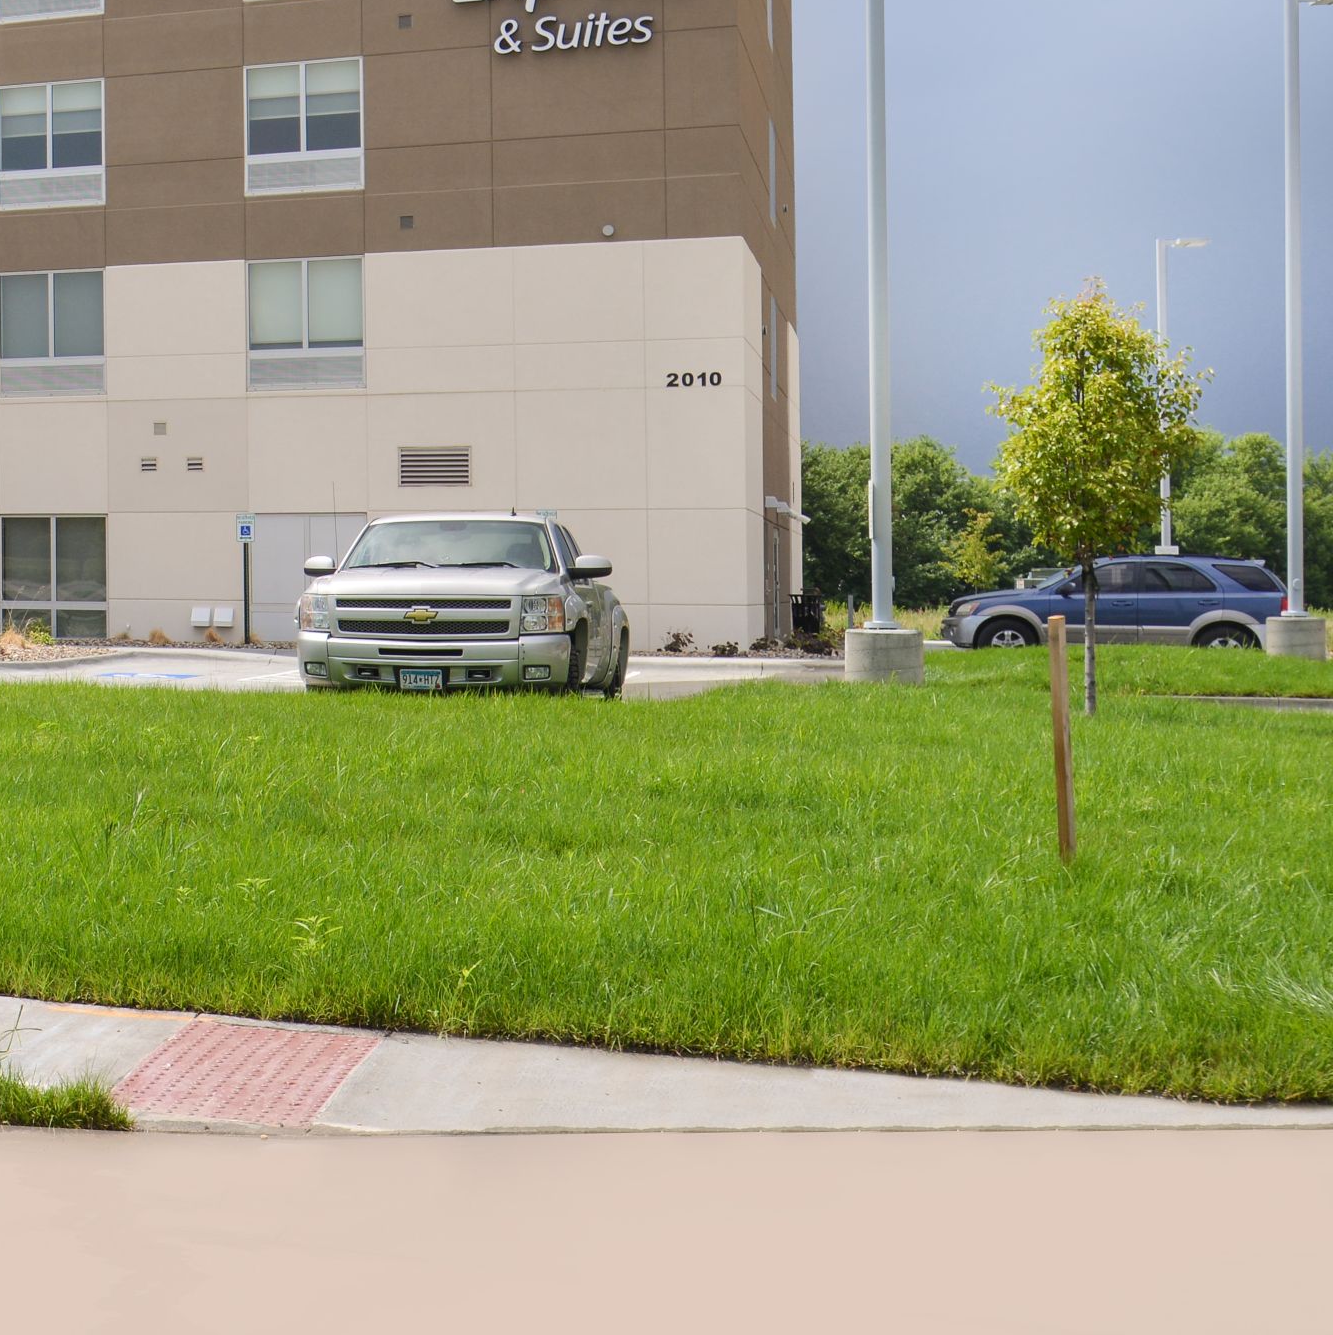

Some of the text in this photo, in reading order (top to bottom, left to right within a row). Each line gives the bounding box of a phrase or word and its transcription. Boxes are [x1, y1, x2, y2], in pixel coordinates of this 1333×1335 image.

[493, 12, 654, 55] & Suites
[666, 372, 722, 387] 2010
